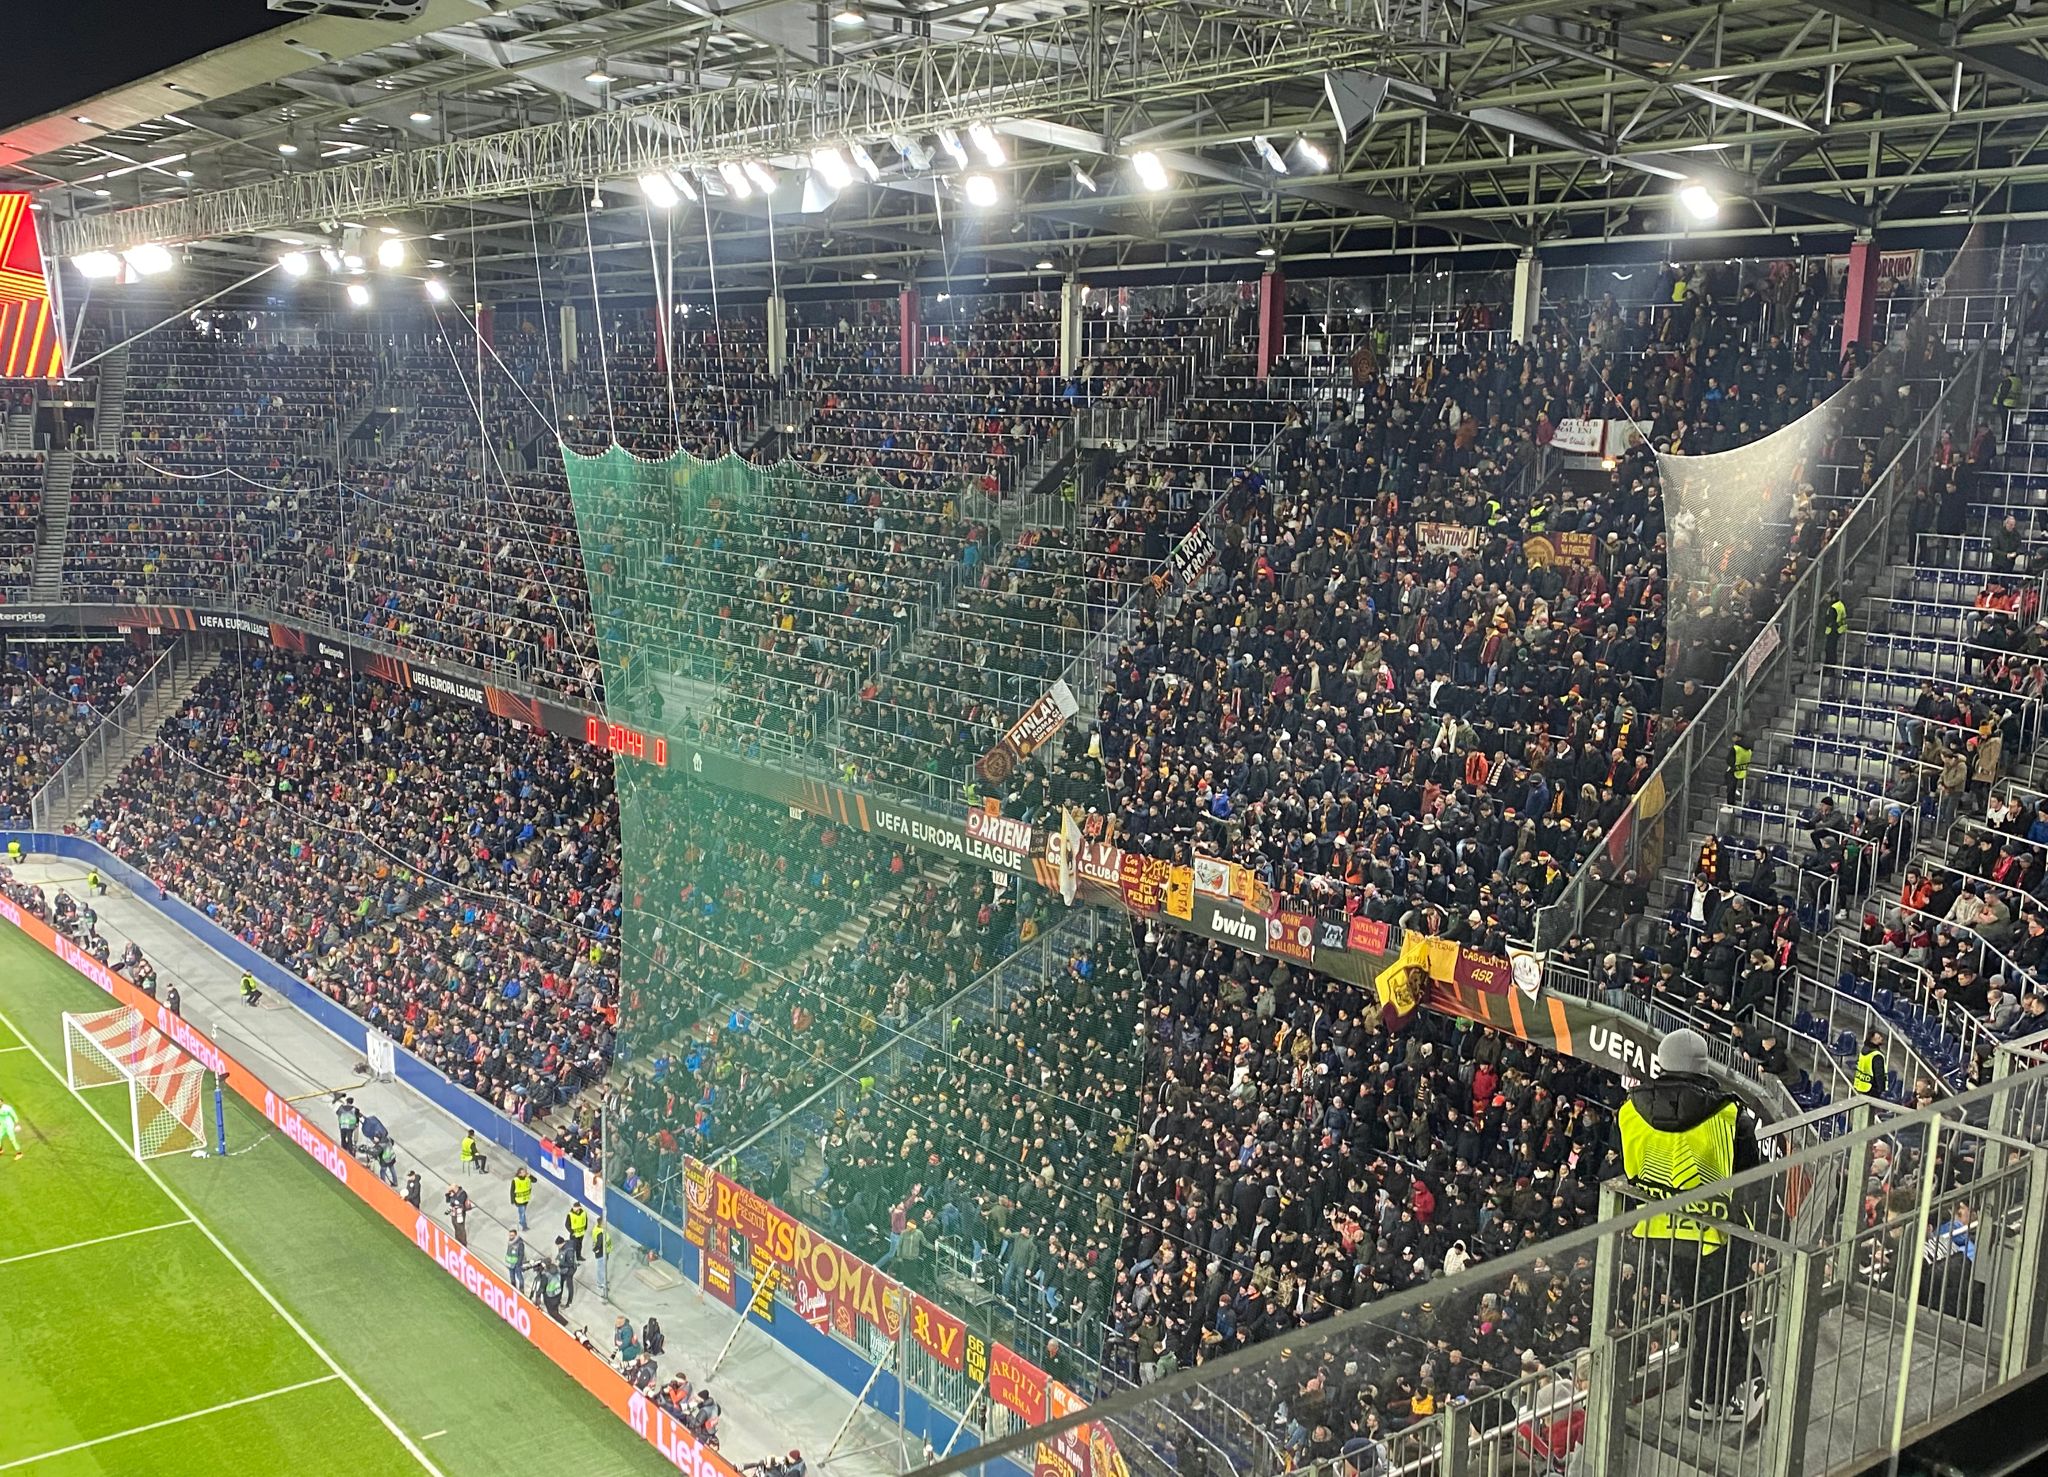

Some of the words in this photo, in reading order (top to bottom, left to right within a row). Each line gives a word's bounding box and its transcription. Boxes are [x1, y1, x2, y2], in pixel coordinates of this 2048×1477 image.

[1174, 553, 1186, 570] A
[1181, 563, 1196, 584] DE
[1191, 540, 1215, 574] ROMA
[200, 615, 224, 629] UEFA
[225, 617, 251, 633] EUROPA
[250, 620, 270, 638] LEAGUE
[412, 670, 430, 687] UEFA
[430, 676, 456, 696] EUROPA
[456, 682, 483, 703] LEAGUE
[588, 718, 597, 746] 0
[656, 738, 666, 767] 0
[1032, 716, 1054, 739] ROMA
[876, 809, 910, 837] UEFA
[912, 820, 964, 855] EUROPA
[965, 836, 1023, 872] LEAGUE
[978, 814, 1032, 852] ARTENA
[1084, 861, 1112, 881] CLUB
[1212, 909, 1257, 942] bwin
[1280, 911, 1303, 927] DONNE
[1286, 929, 1295, 940] IN
[66, 942, 114, 994] Lieferando
[1470, 968, 1494, 984] ASR
[169, 1015, 226, 1076] Lieferando
[1589, 1024, 1646, 1074] UEFA
[277, 1099, 348, 1183] Lieferando
[434, 1227, 532, 1338] Lieferando
[794, 1224, 880, 1325] ROMA
[966, 1348, 986, 1371] CON
[967, 1334, 985, 1355] 66
[991, 1360, 1042, 1406] ARDITI
[1002, 1388, 1031, 1415] ROMA
